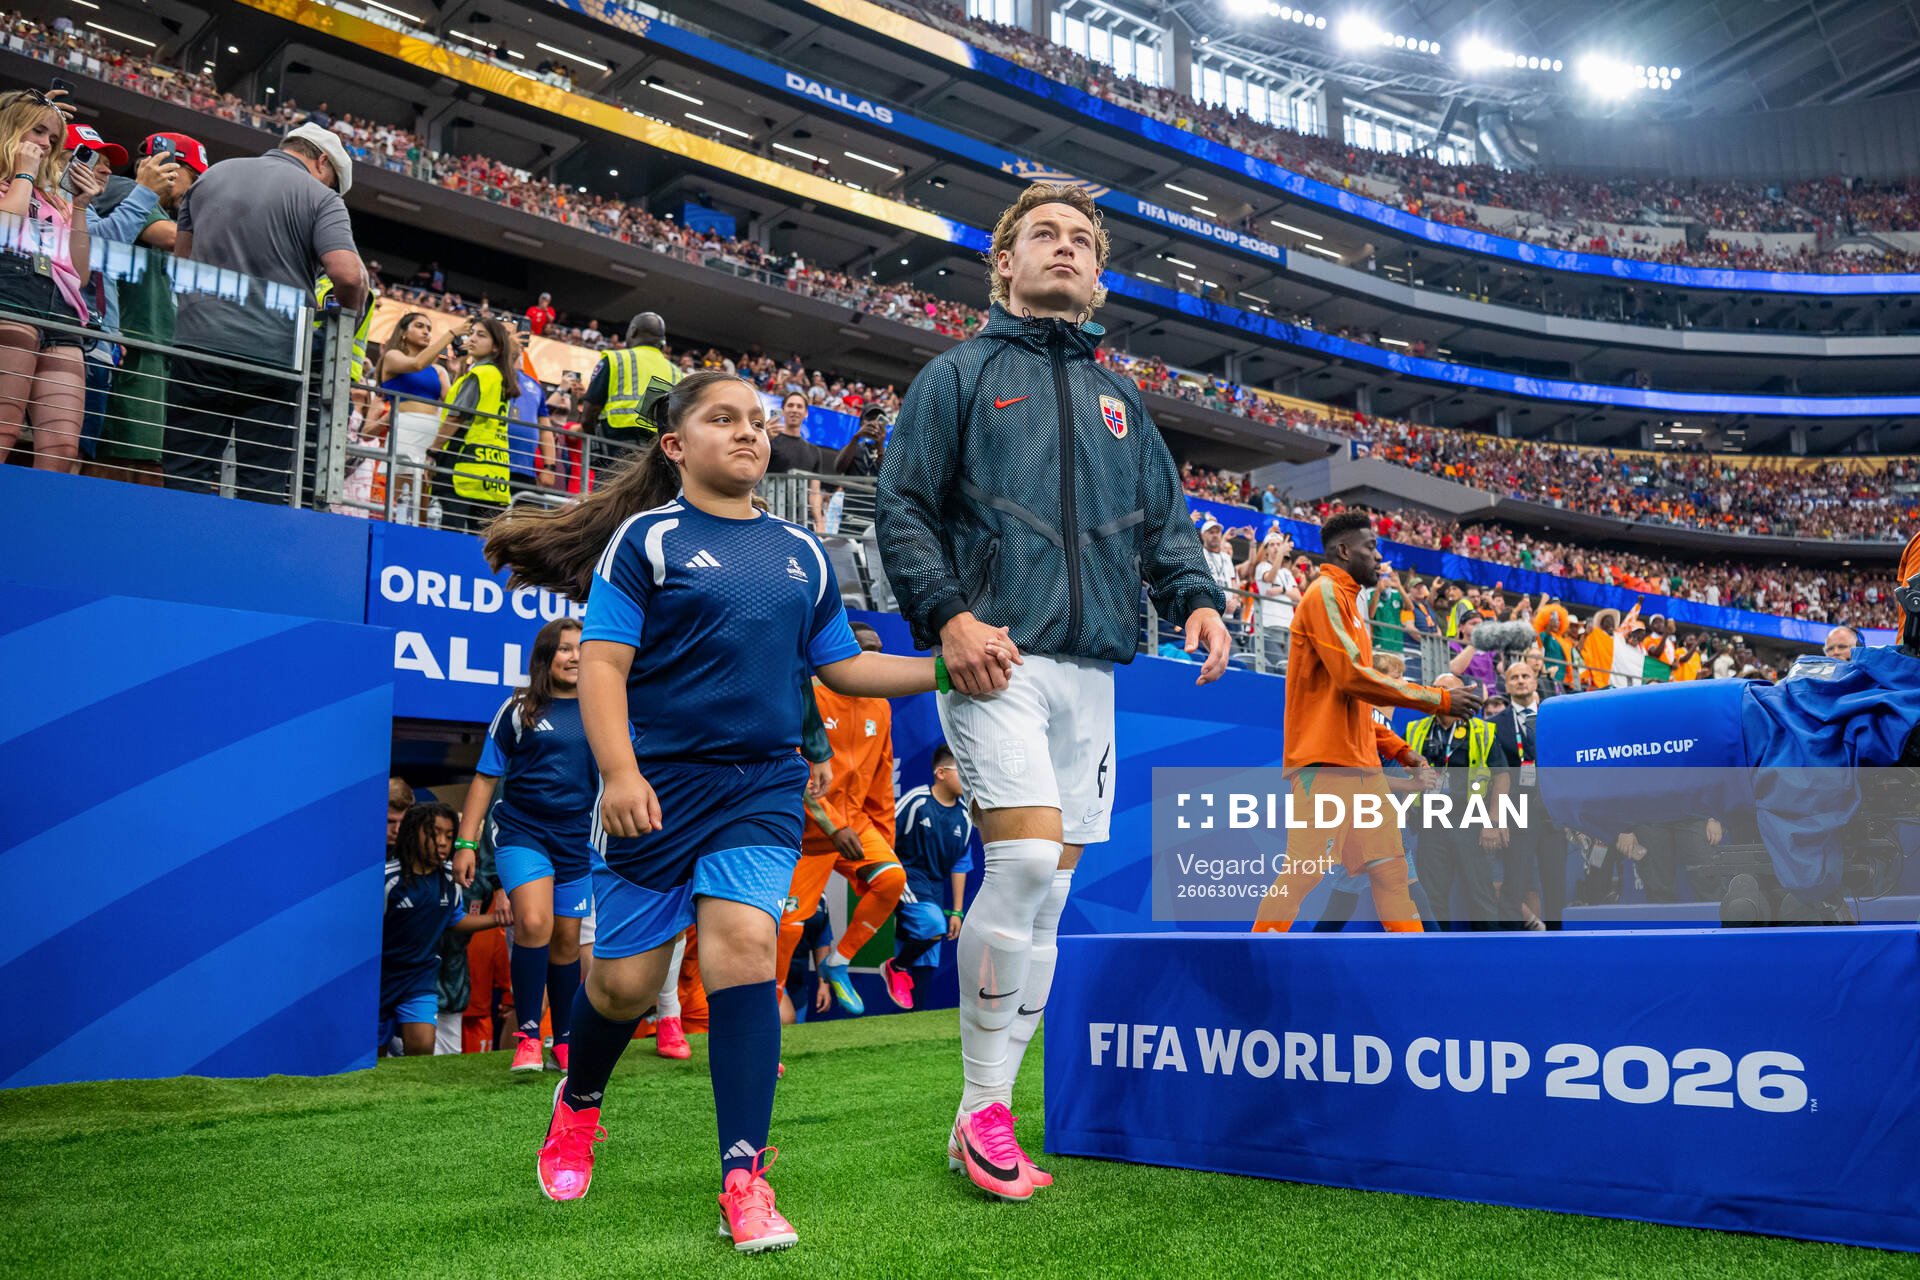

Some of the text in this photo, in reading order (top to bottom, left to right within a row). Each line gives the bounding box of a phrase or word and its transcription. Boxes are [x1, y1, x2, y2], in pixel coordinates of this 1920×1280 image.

[786, 72, 894, 124] DALLAS
[1137, 200, 1280, 259] FIFA WORLD CUP 2026
[1576, 748, 1607, 763] FIFA
[1607, 742, 1662, 759] WORLD
[1089, 1022, 1188, 1073] FIFA
[1195, 1027, 1393, 1085] WORLD
[1405, 1036, 1531, 1095] CUP
[1545, 1043, 1808, 1113] 2026
